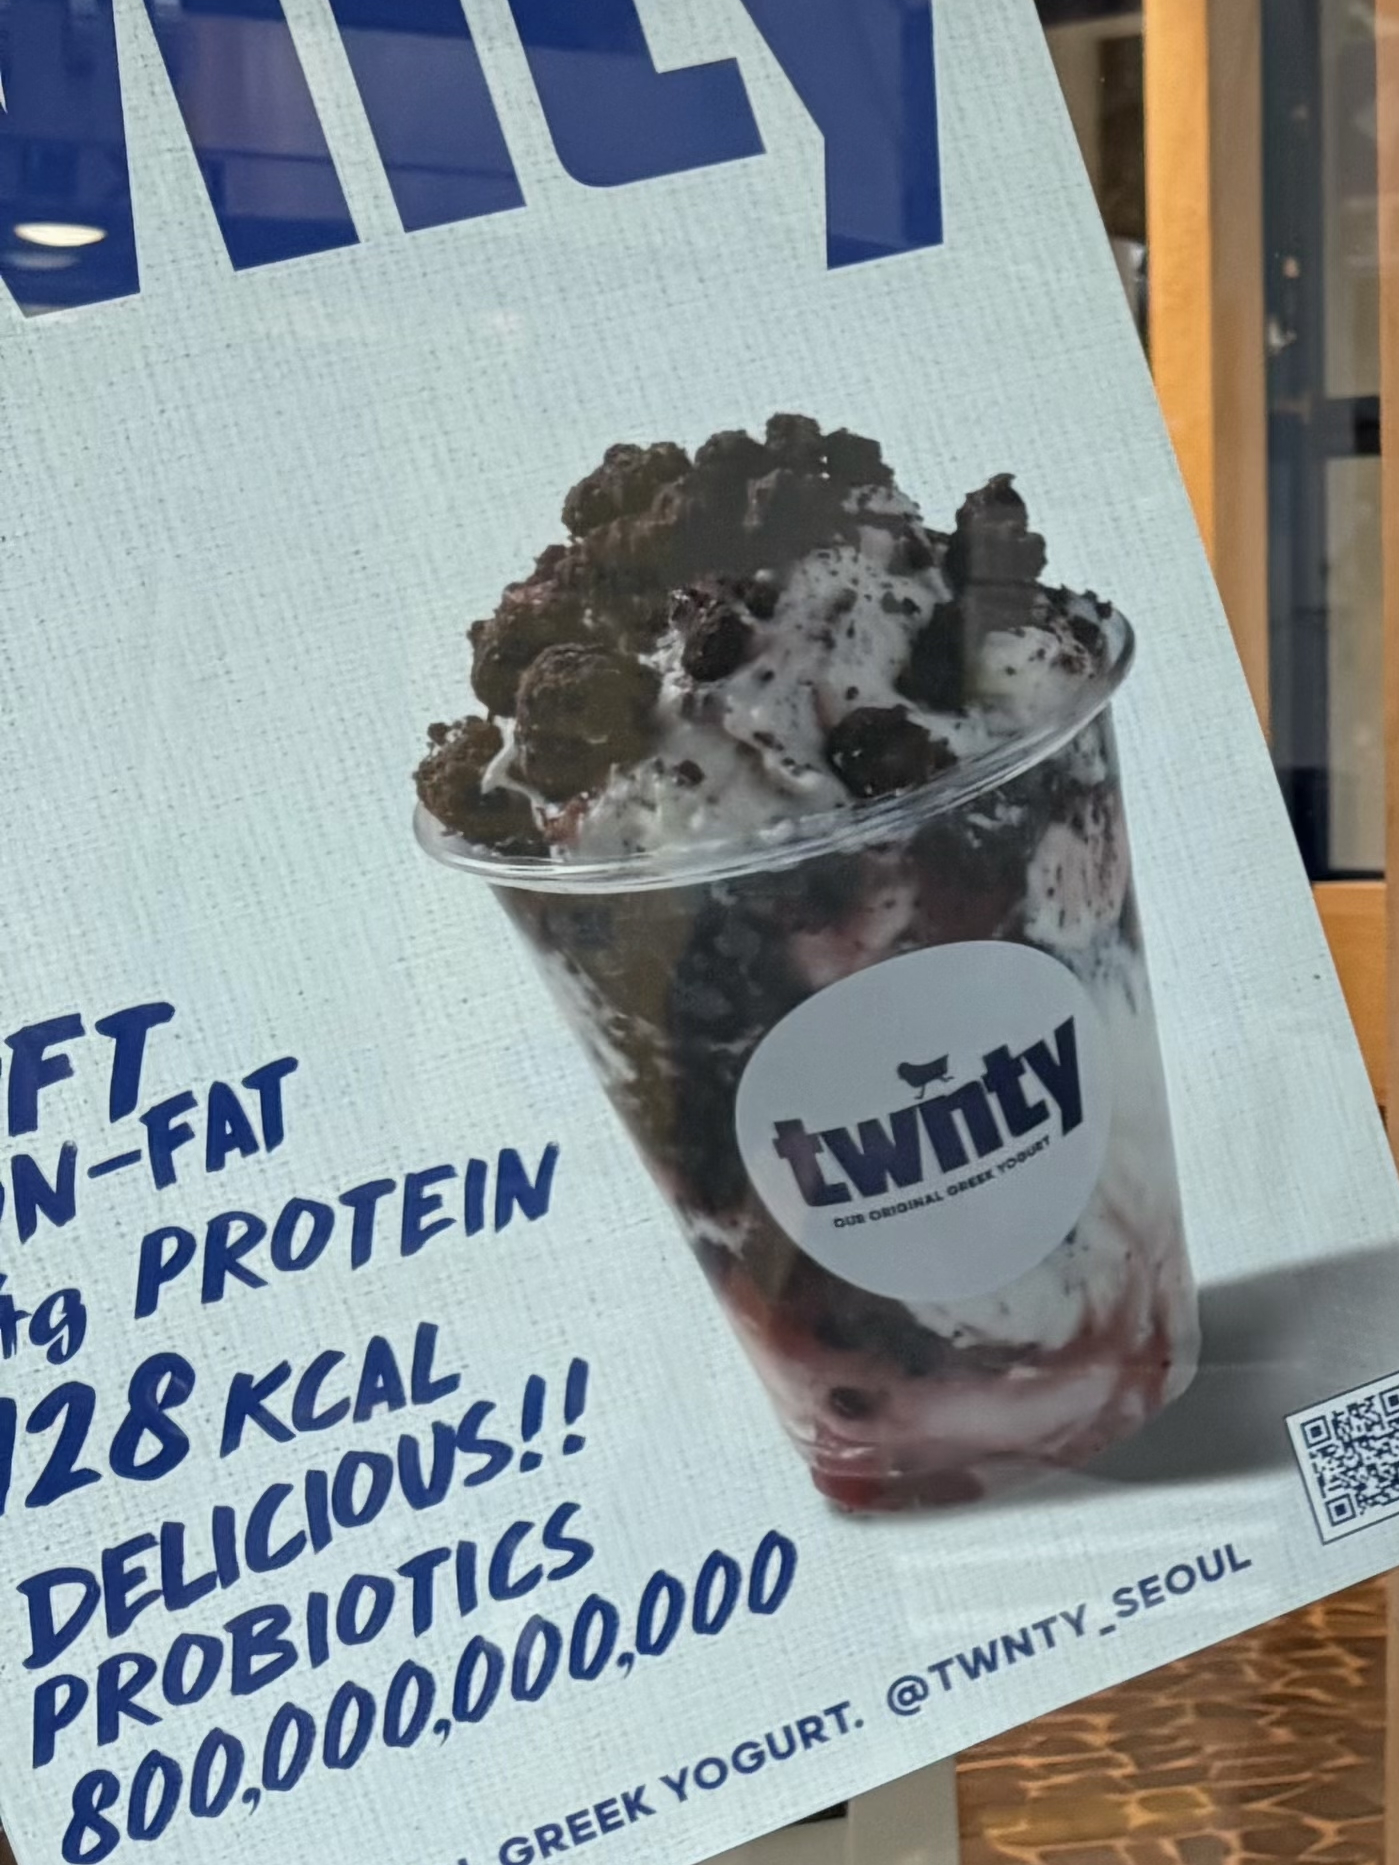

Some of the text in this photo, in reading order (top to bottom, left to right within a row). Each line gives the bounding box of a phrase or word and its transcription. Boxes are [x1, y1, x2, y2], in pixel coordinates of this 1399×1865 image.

[0, 1001, 175, 1135] FT
[0, 1057, 298, 1243] N-FAT
[772, 1015, 1084, 1208] twnty
[135, 1141, 560, 1319] PROTEIN
[868, 1190, 945, 1222] ORIGINAL
[946, 1169, 996, 1197] GREEK
[996, 1135, 1051, 1175] YOGURT
[220, 1322, 460, 1458] KCAL
[16, 1358, 590, 1670] DELICIOUS!!
[33, 1502, 594, 1769] PROBIOTICS
[61, 1530, 798, 1865] 800,000,000,000
[659, 1699, 865, 1804] YOGURT.
[886, 1542, 1253, 1718] @TWNTY_SEOUL
